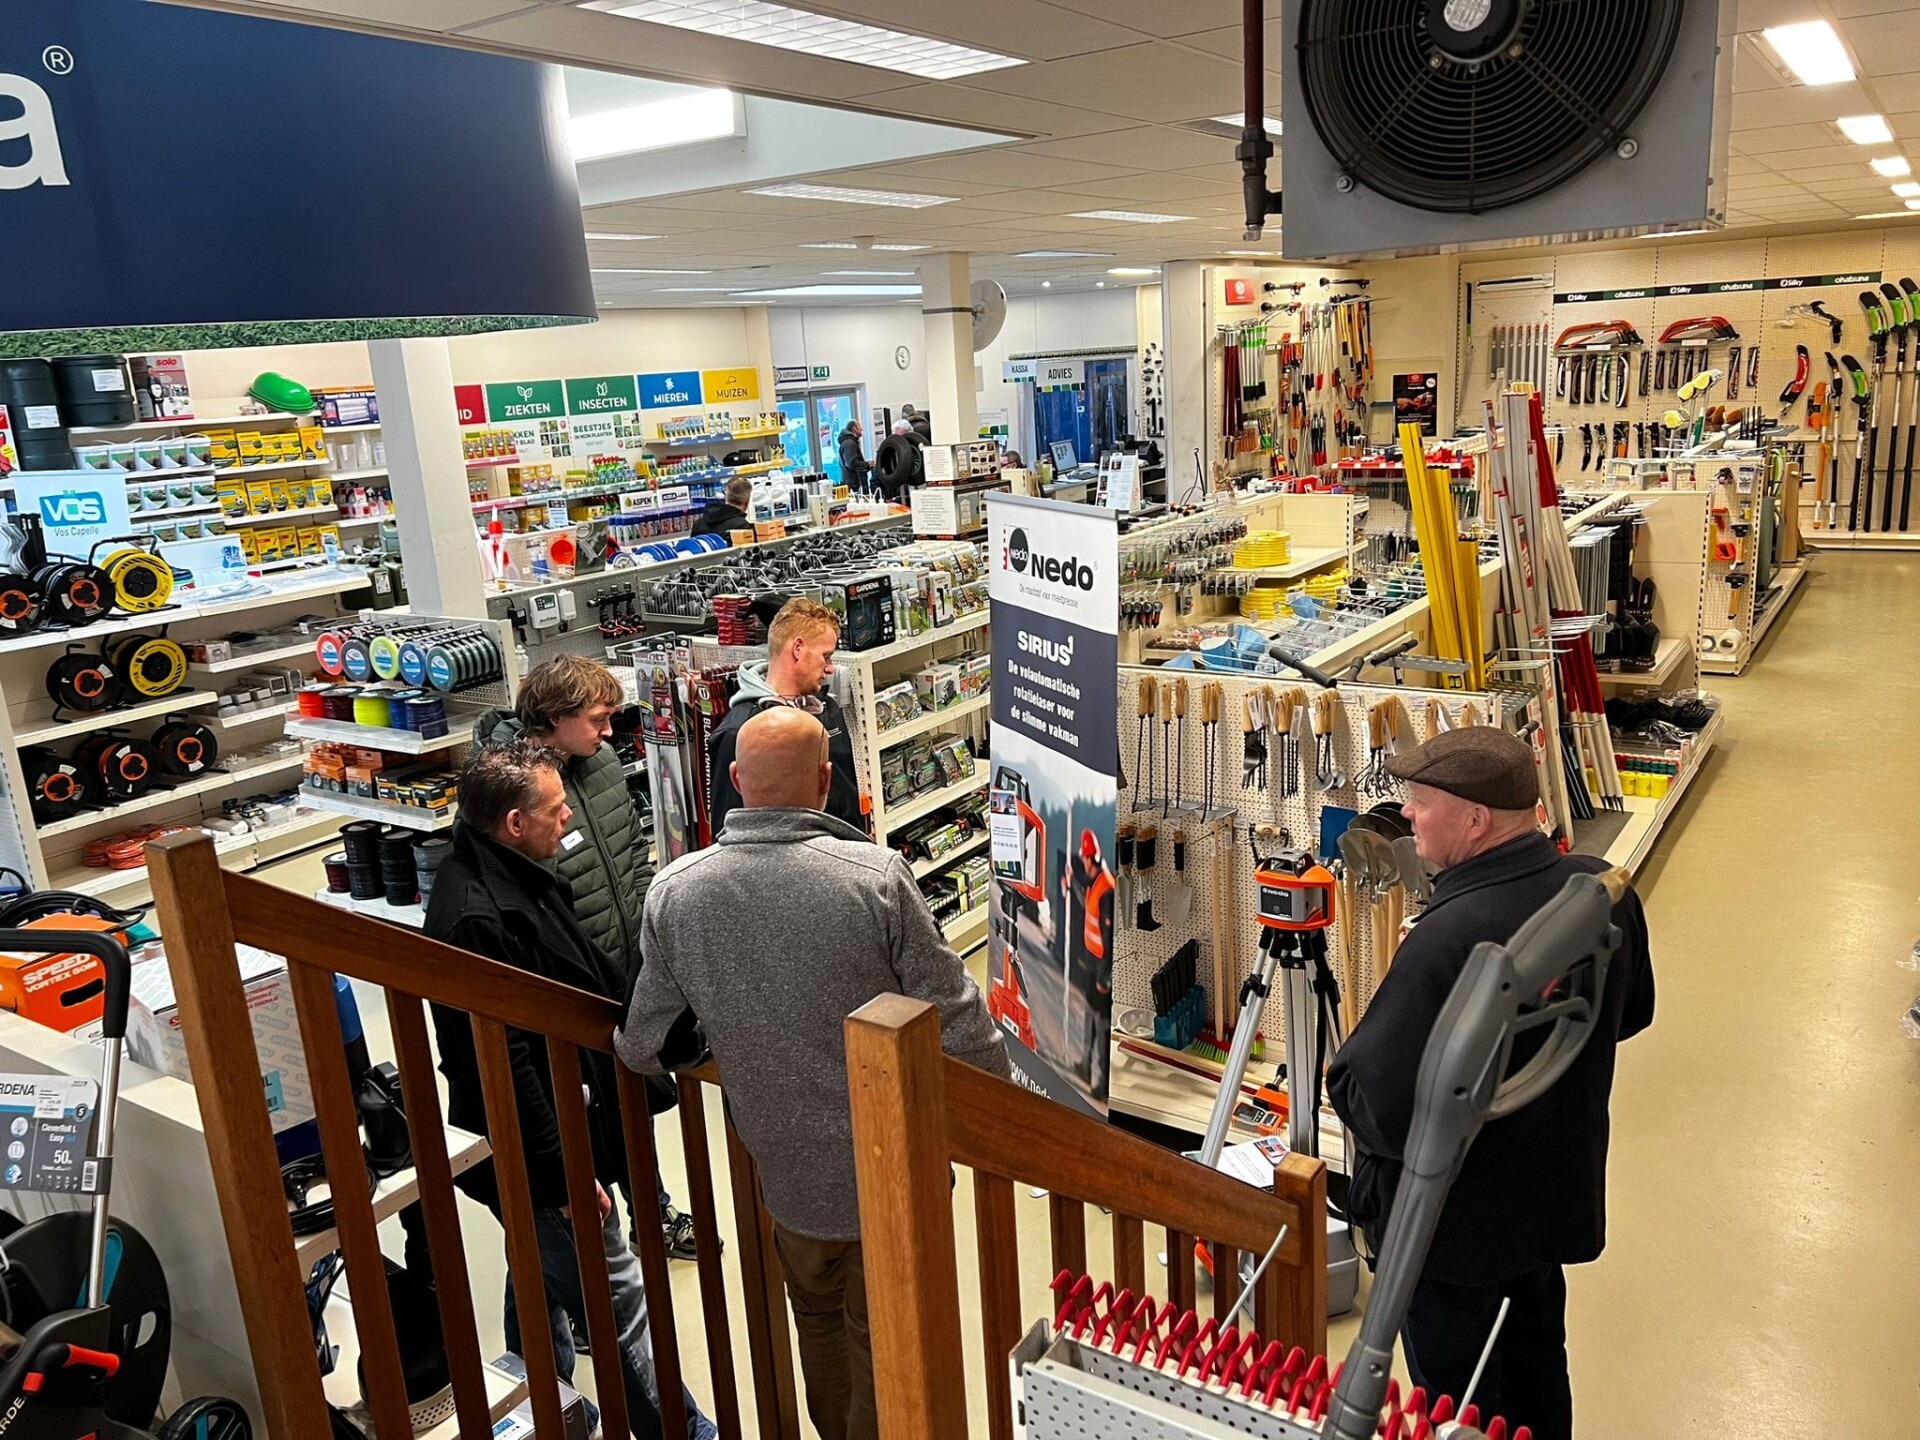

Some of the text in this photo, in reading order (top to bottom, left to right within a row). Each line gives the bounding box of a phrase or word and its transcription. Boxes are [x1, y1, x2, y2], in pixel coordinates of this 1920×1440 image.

[156, 357, 177, 366] solo
[1011, 365, 1029, 374] KASSA
[1048, 368, 1073, 380] ADVIES
[653, 392, 689, 404] MIEREN
[716, 387, 748, 399] MUIZEN
[504, 402, 551, 417] ZIEKTEN
[578, 397, 628, 411] INSECTEN
[573, 422, 612, 433] BEESTJES
[633, 497, 651, 506] ASPEN
[43, 498, 101, 522] VOS
[54, 525, 99, 537] Vos Capelle
[1031, 553, 1094, 591] Nedo
[856, 582, 879, 594] GARDENA
[1008, 659, 1019, 675] De
[1013, 686, 1075, 721] rotatielaser voor
[1010, 705, 1079, 748] de slimme vakman
[23, 953, 91, 986] SPEED
[25, 971, 72, 993] VORTEX
[49, 1133, 64, 1144] Easy
